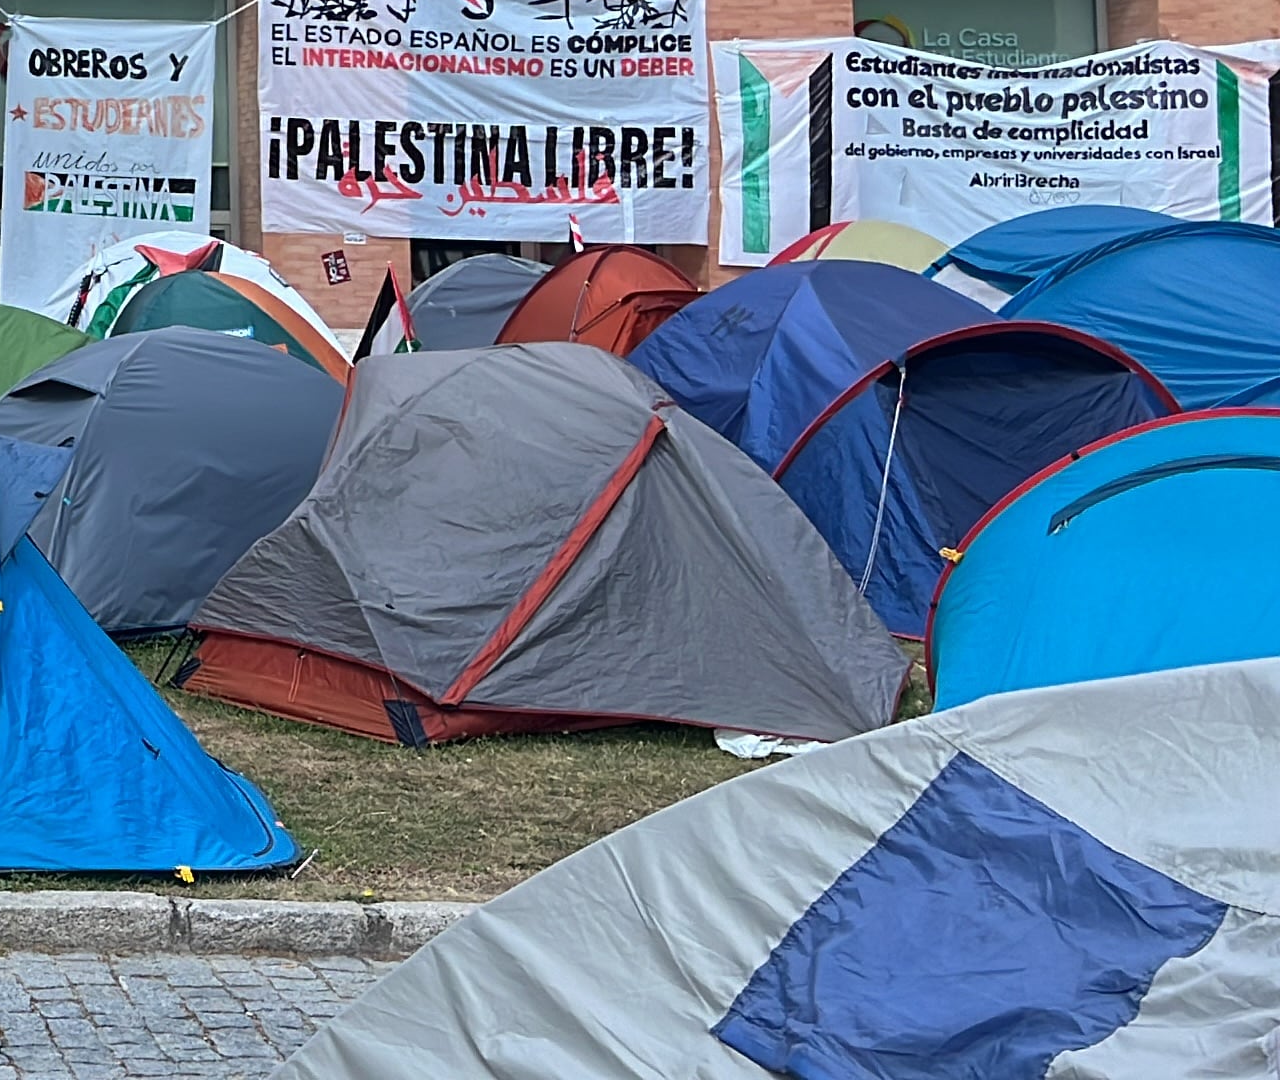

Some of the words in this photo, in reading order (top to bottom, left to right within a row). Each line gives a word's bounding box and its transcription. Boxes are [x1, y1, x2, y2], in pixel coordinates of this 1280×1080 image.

[272, 24, 297, 41] EL
[305, 25, 402, 46] ESTADO
[410, 28, 524, 52] ESPAÑOL
[532, 35, 560, 53] ES
[567, 31, 692, 54] CÓMPLICE
[923, 27, 950, 47] La
[959, 28, 1019, 47] Casa
[29, 48, 148, 81] OBREROS
[168, 52, 189, 82] Y
[272, 47, 296, 65] EL
[303, 48, 544, 77] INTERNACIONALISMO
[550, 58, 577, 77] ES
[584, 58, 615, 78] UN
[620, 57, 694, 77] DEBER
[845, 51, 985, 80] Estudiantes
[847, 87, 899, 108] con
[908, 84, 939, 110] el
[946, 86, 1054, 117] pueblo
[1061, 81, 1209, 119] palestino
[902, 118, 967, 139] Basta
[972, 120, 1003, 140] de
[1007, 119, 1149, 146] complicidad
[269, 117, 532, 187] ¡PALESTINA
[545, 126, 695, 188] LIBRE!
[845, 143, 866, 156] del
[868, 144, 939, 160] gobierno,
[942, 148, 1017, 161] empresas
[1021, 151, 1031, 162] y
[1034, 146, 1142, 160] universidades
[1145, 149, 1174, 160] con
[1177, 146, 1221, 159] Israel
[44, 171, 177, 221] PALESTINA
